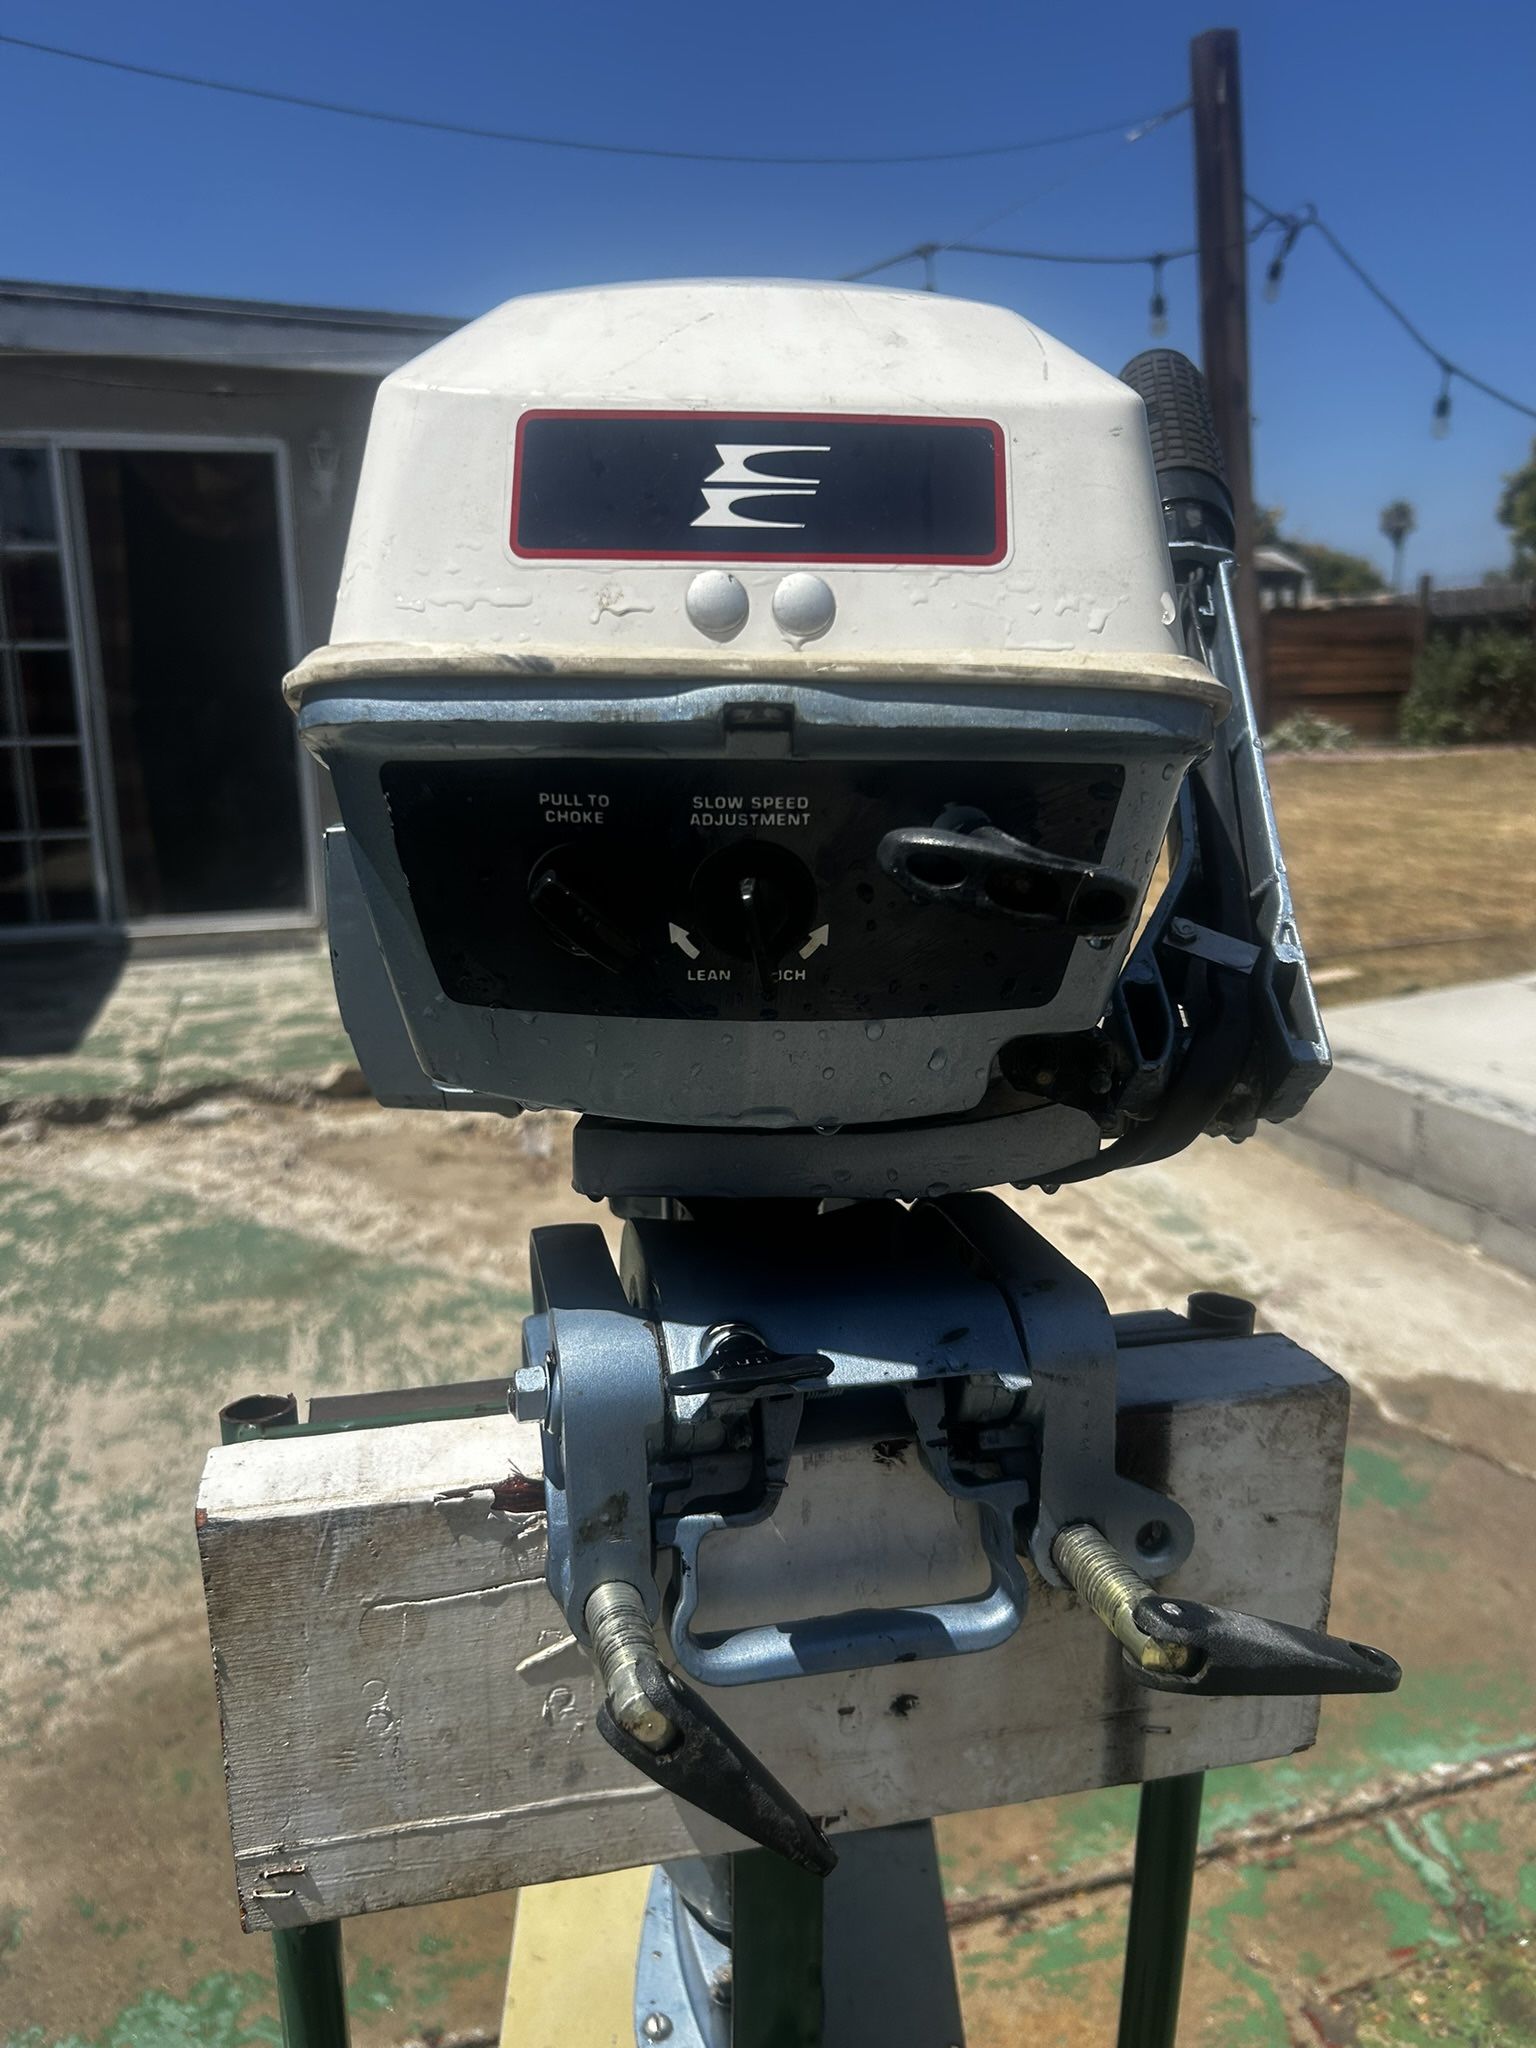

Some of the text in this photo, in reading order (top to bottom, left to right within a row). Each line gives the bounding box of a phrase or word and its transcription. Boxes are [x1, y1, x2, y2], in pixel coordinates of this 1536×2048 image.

[538, 793, 610, 808] PULL TO
[692, 796, 809, 810] SLOW SPEED
[545, 810, 603, 825] CHOKE
[689, 813, 811, 826] ADJUSTMENT
[687, 969, 731, 981] LEAN
[774, 969, 806, 981] ICH
